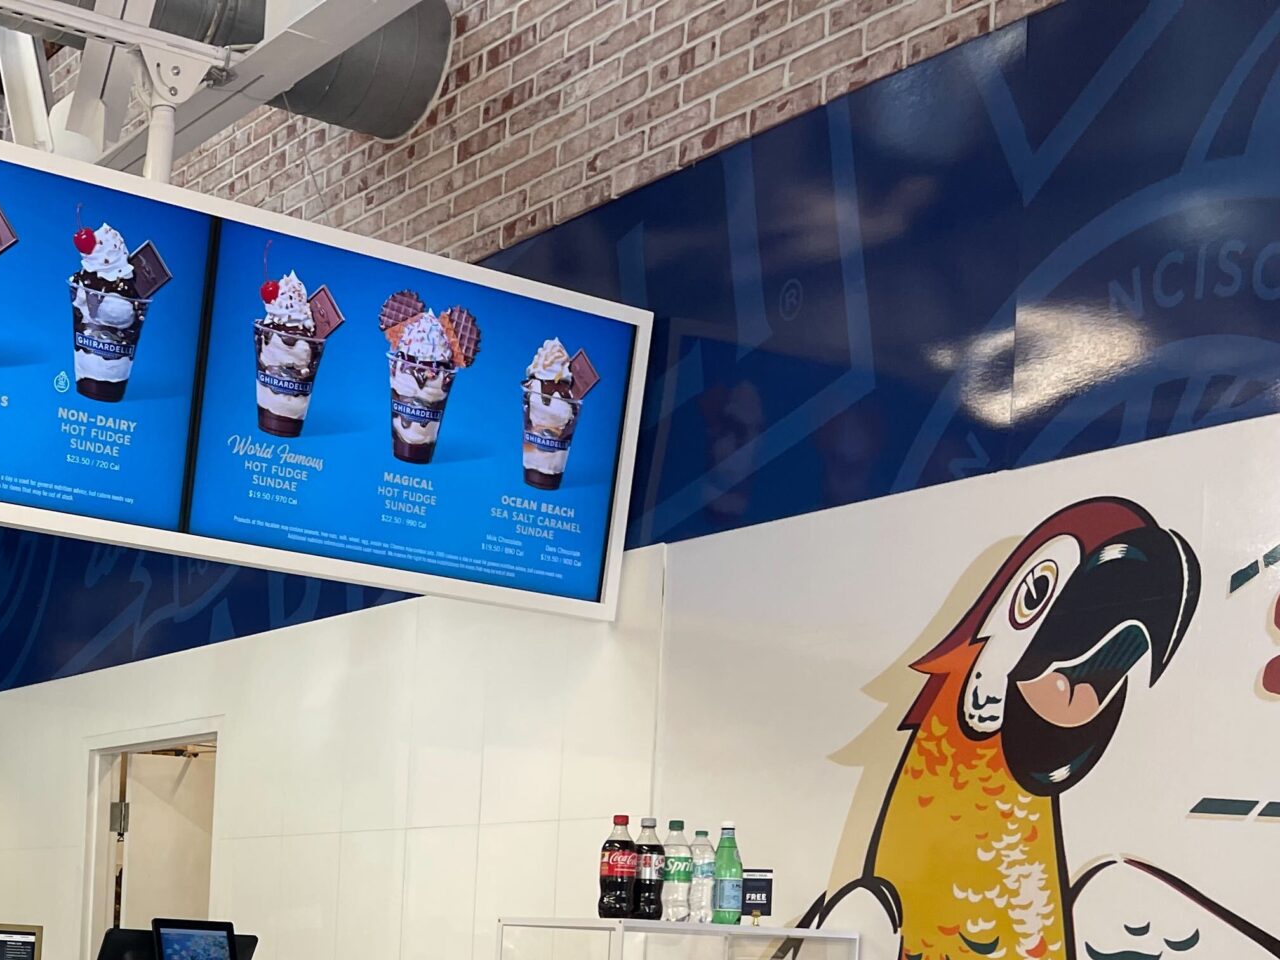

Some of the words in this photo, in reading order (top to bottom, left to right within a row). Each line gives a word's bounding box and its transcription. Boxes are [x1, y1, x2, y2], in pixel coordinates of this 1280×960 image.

[77, 336, 132, 354] GHIRARDELLI
[259, 374, 310, 392] GHIRARDELLI
[57, 407, 137, 433] NON-DAIRY
[60, 422, 87, 437] HOT
[90, 428, 132, 446] FUDGE
[69, 438, 120, 457] SUNDAE
[227, 434, 275, 459] World
[276, 443, 324, 472] Famous
[95, 460, 109, 469] 720
[109, 463, 120, 471] Cal
[244, 459, 268, 473] HOT
[271, 465, 309, 481] FUDGE
[252, 474, 298, 492] SUNDAE
[383, 471, 434, 491] MAGICAL
[377, 485, 400, 498] HOT
[402, 490, 438, 506] FUDGE
[384, 499, 427, 516] SUNDAE
[500, 495, 538, 511] OCEAN
[540, 502, 575, 518] BEACH
[490, 507, 509, 520] SEA
[511, 511, 535, 524] SALT
[537, 516, 582, 534] CARAMEL
[515, 524, 555, 540] SUNDAE
[745, 893, 767, 901] FREE
